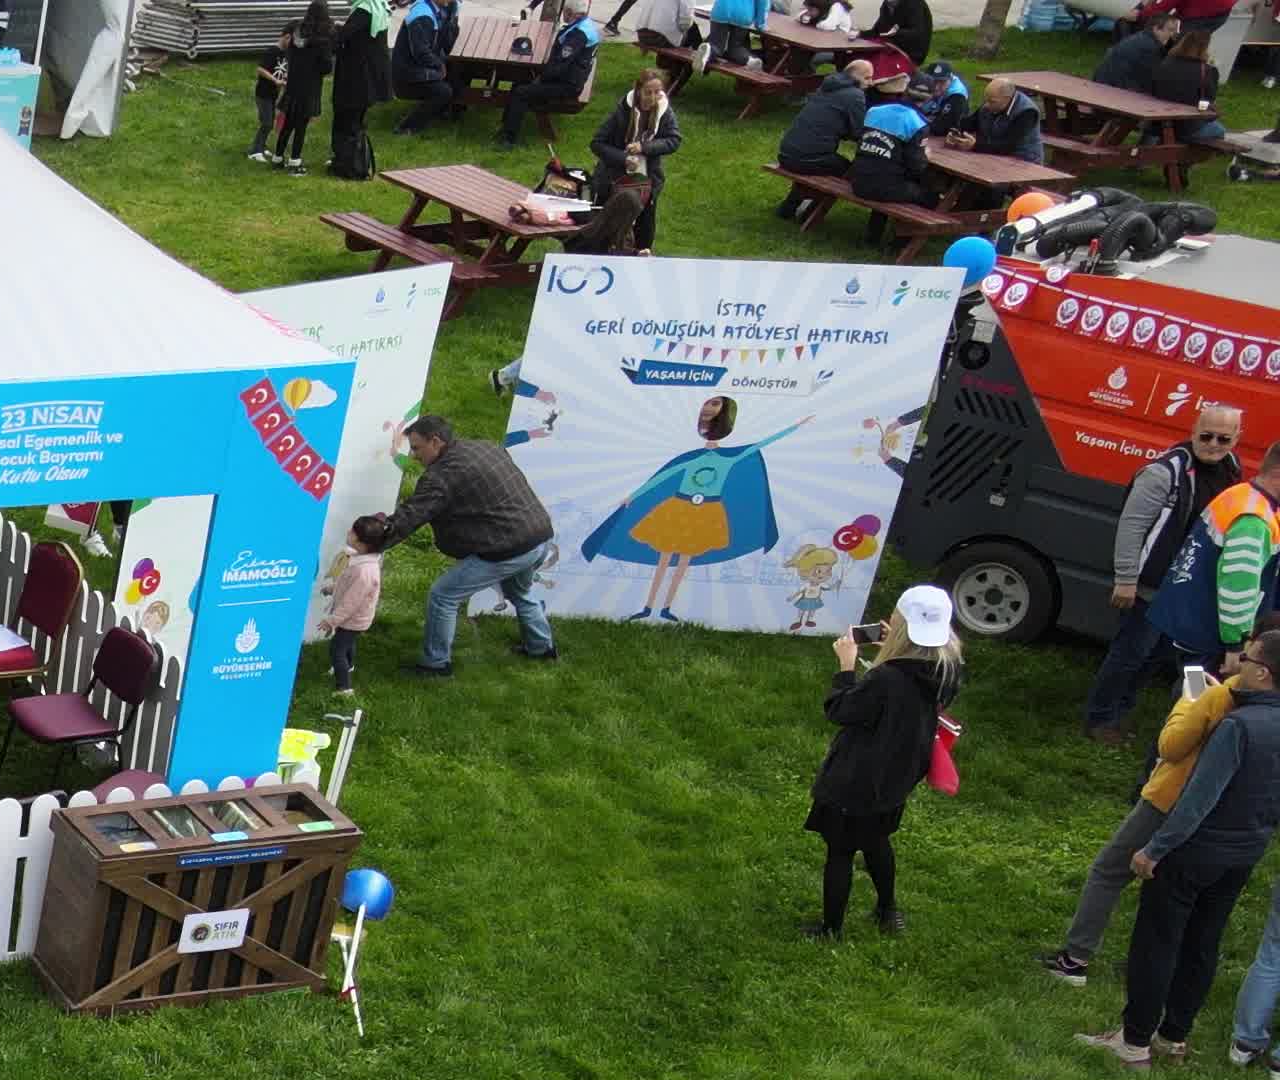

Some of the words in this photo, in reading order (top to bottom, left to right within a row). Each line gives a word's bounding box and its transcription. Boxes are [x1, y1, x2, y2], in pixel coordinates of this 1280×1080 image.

[717, 299, 766, 321] İSTAÇ
[585, 316, 625, 336] GERİ
[632, 319, 715, 342] DÖNÜŞÜM
[723, 323, 801, 343] ATÖLYESİ
[807, 328, 889, 345] HATIRASI
[1, 410, 26, 429] 23
[24, 430, 102, 450] Egemenlik
[106, 432, 124, 443] ve
[1075, 431, 1117, 451] Yaşam
[40, 448, 104, 466] Bayramı
[45, 465, 89, 481] Olsun
[214, 920, 239, 931] SIFIR
